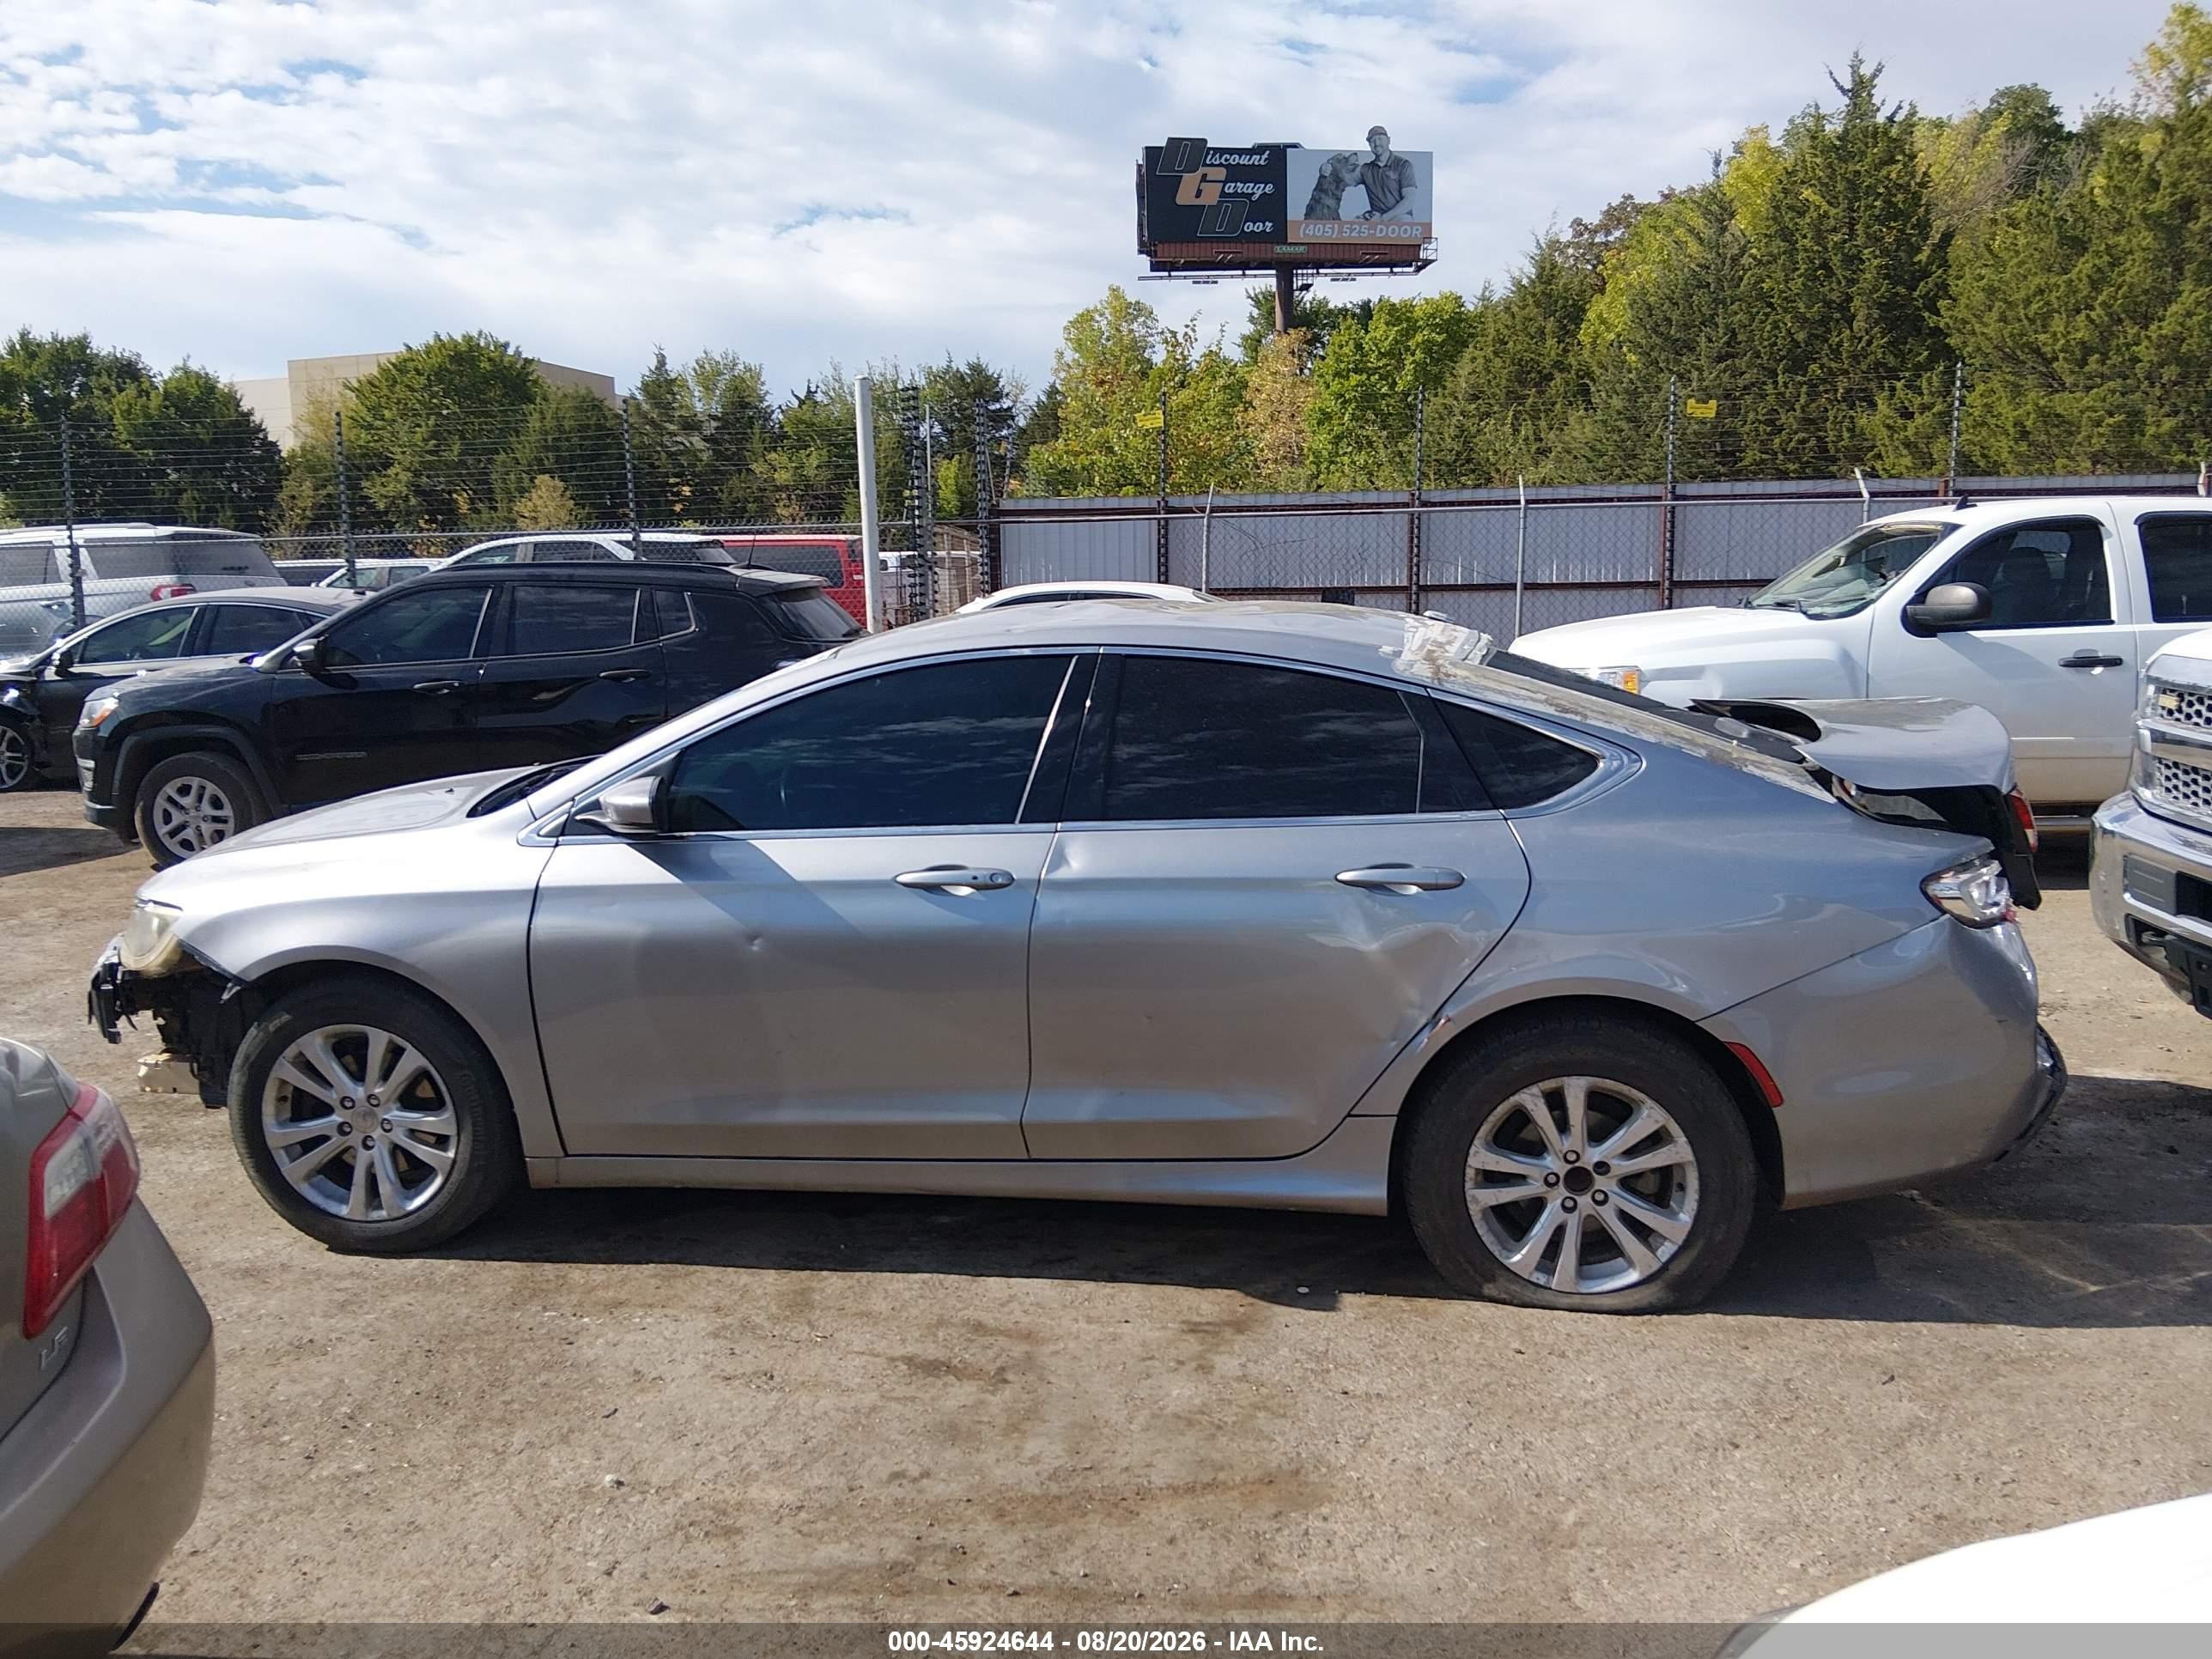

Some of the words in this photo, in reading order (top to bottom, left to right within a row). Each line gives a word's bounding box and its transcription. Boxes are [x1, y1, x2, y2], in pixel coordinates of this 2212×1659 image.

[1156, 137, 1270, 175] Discount
[1175, 167, 1275, 206] Garage
[1197, 198, 1274, 237] Door
[1299, 223, 1338, 239] (405)
[1342, 224, 1423, 238] 525-DOOR
